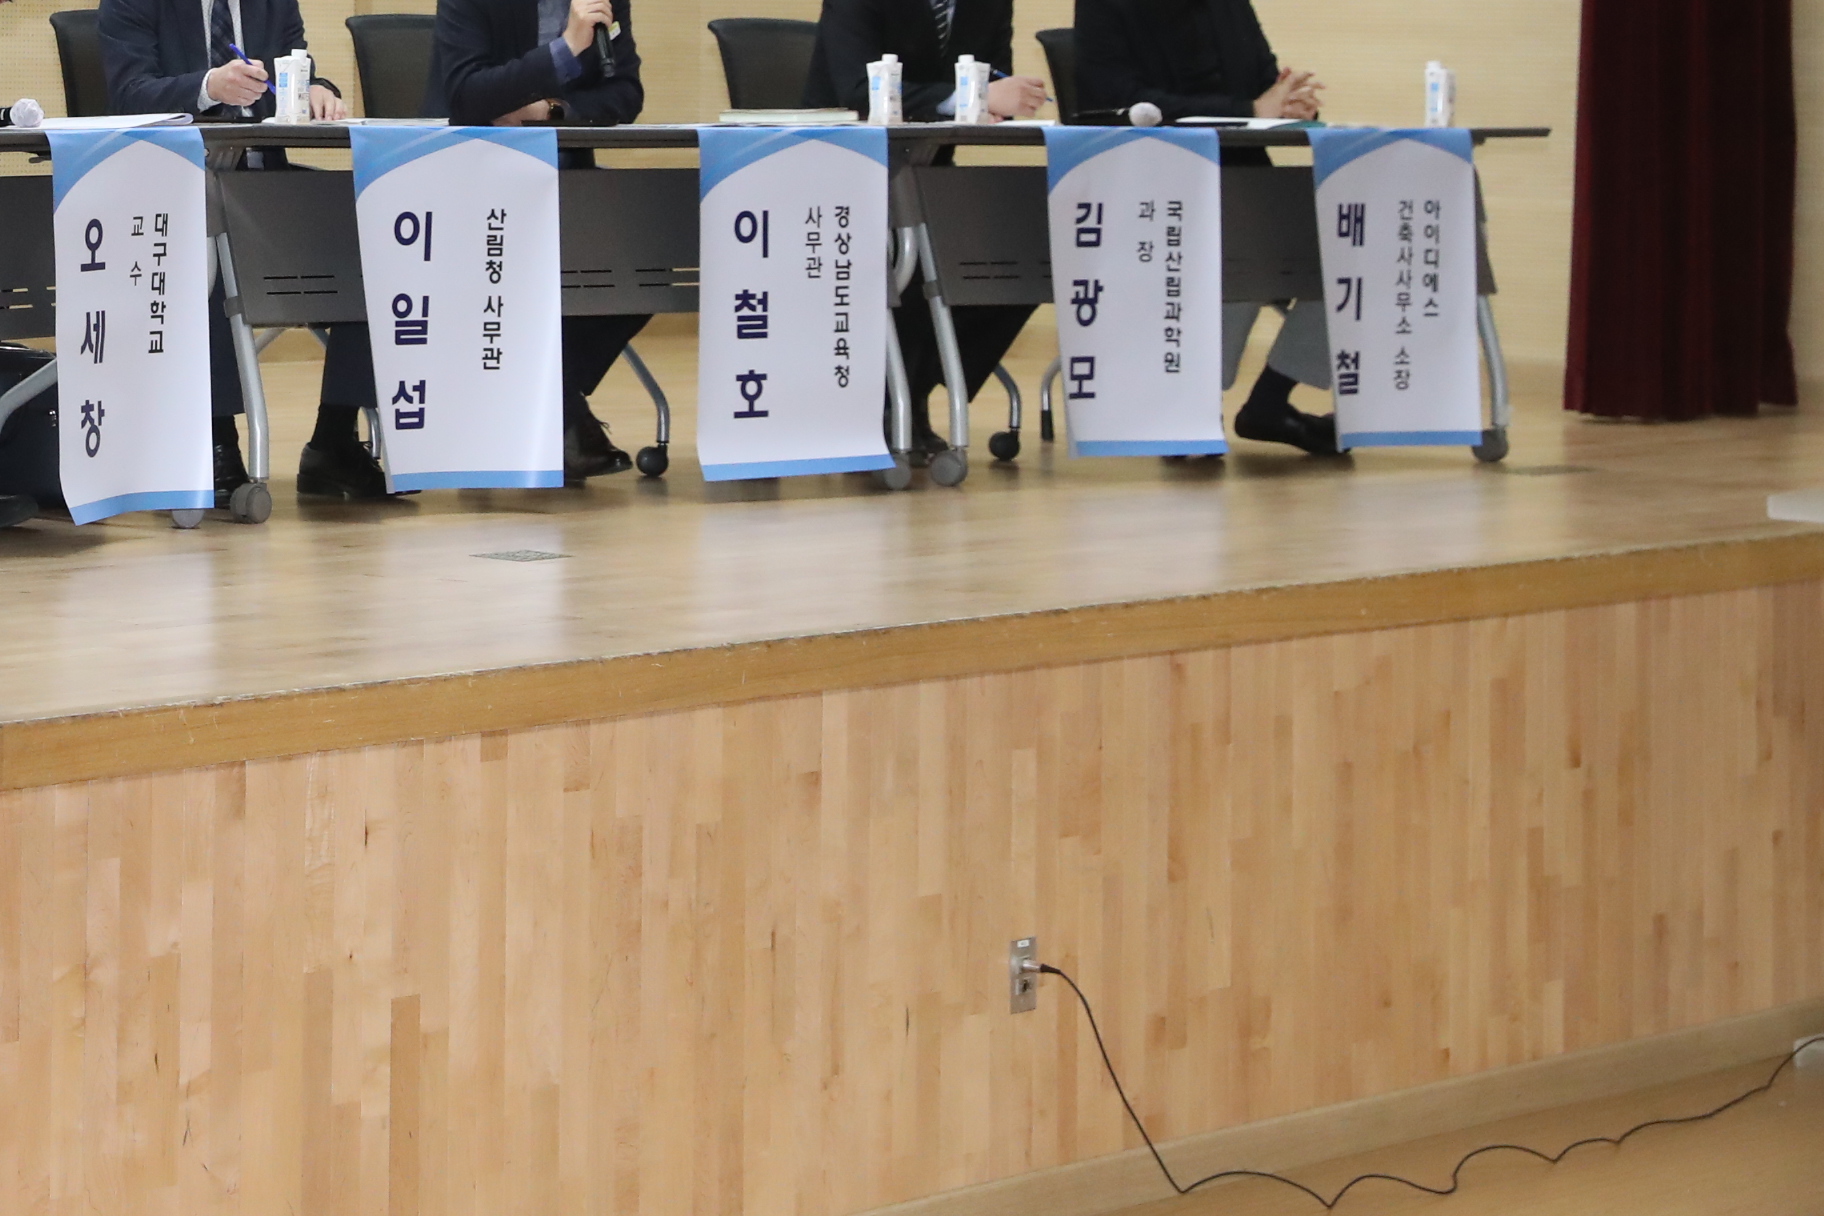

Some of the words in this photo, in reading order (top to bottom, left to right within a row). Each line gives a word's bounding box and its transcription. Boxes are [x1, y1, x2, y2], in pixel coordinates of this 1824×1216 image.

[129, 216, 144, 286] 교수
[148, 213, 168, 354] 대구대학교
[485, 209, 507, 284] 산림청
[805, 206, 823, 279] 사무관
[834, 206, 851, 388] 경상남도교육청
[1137, 200, 1156, 262] 과장
[1164, 201, 1183, 373] 국립산림과학원
[1336, 202, 1365, 396] 배기철
[1395, 200, 1414, 336] 건축사사무소
[1422, 200, 1441, 317] 아이디에스
[80, 218, 105, 458] 오세창
[392, 211, 433, 430] 이일섭
[482, 296, 504, 370] 사무관
[734, 210, 769, 419] 이철호
[1069, 202, 1103, 400] 김광모
[1393, 346, 1410, 390] 소장
